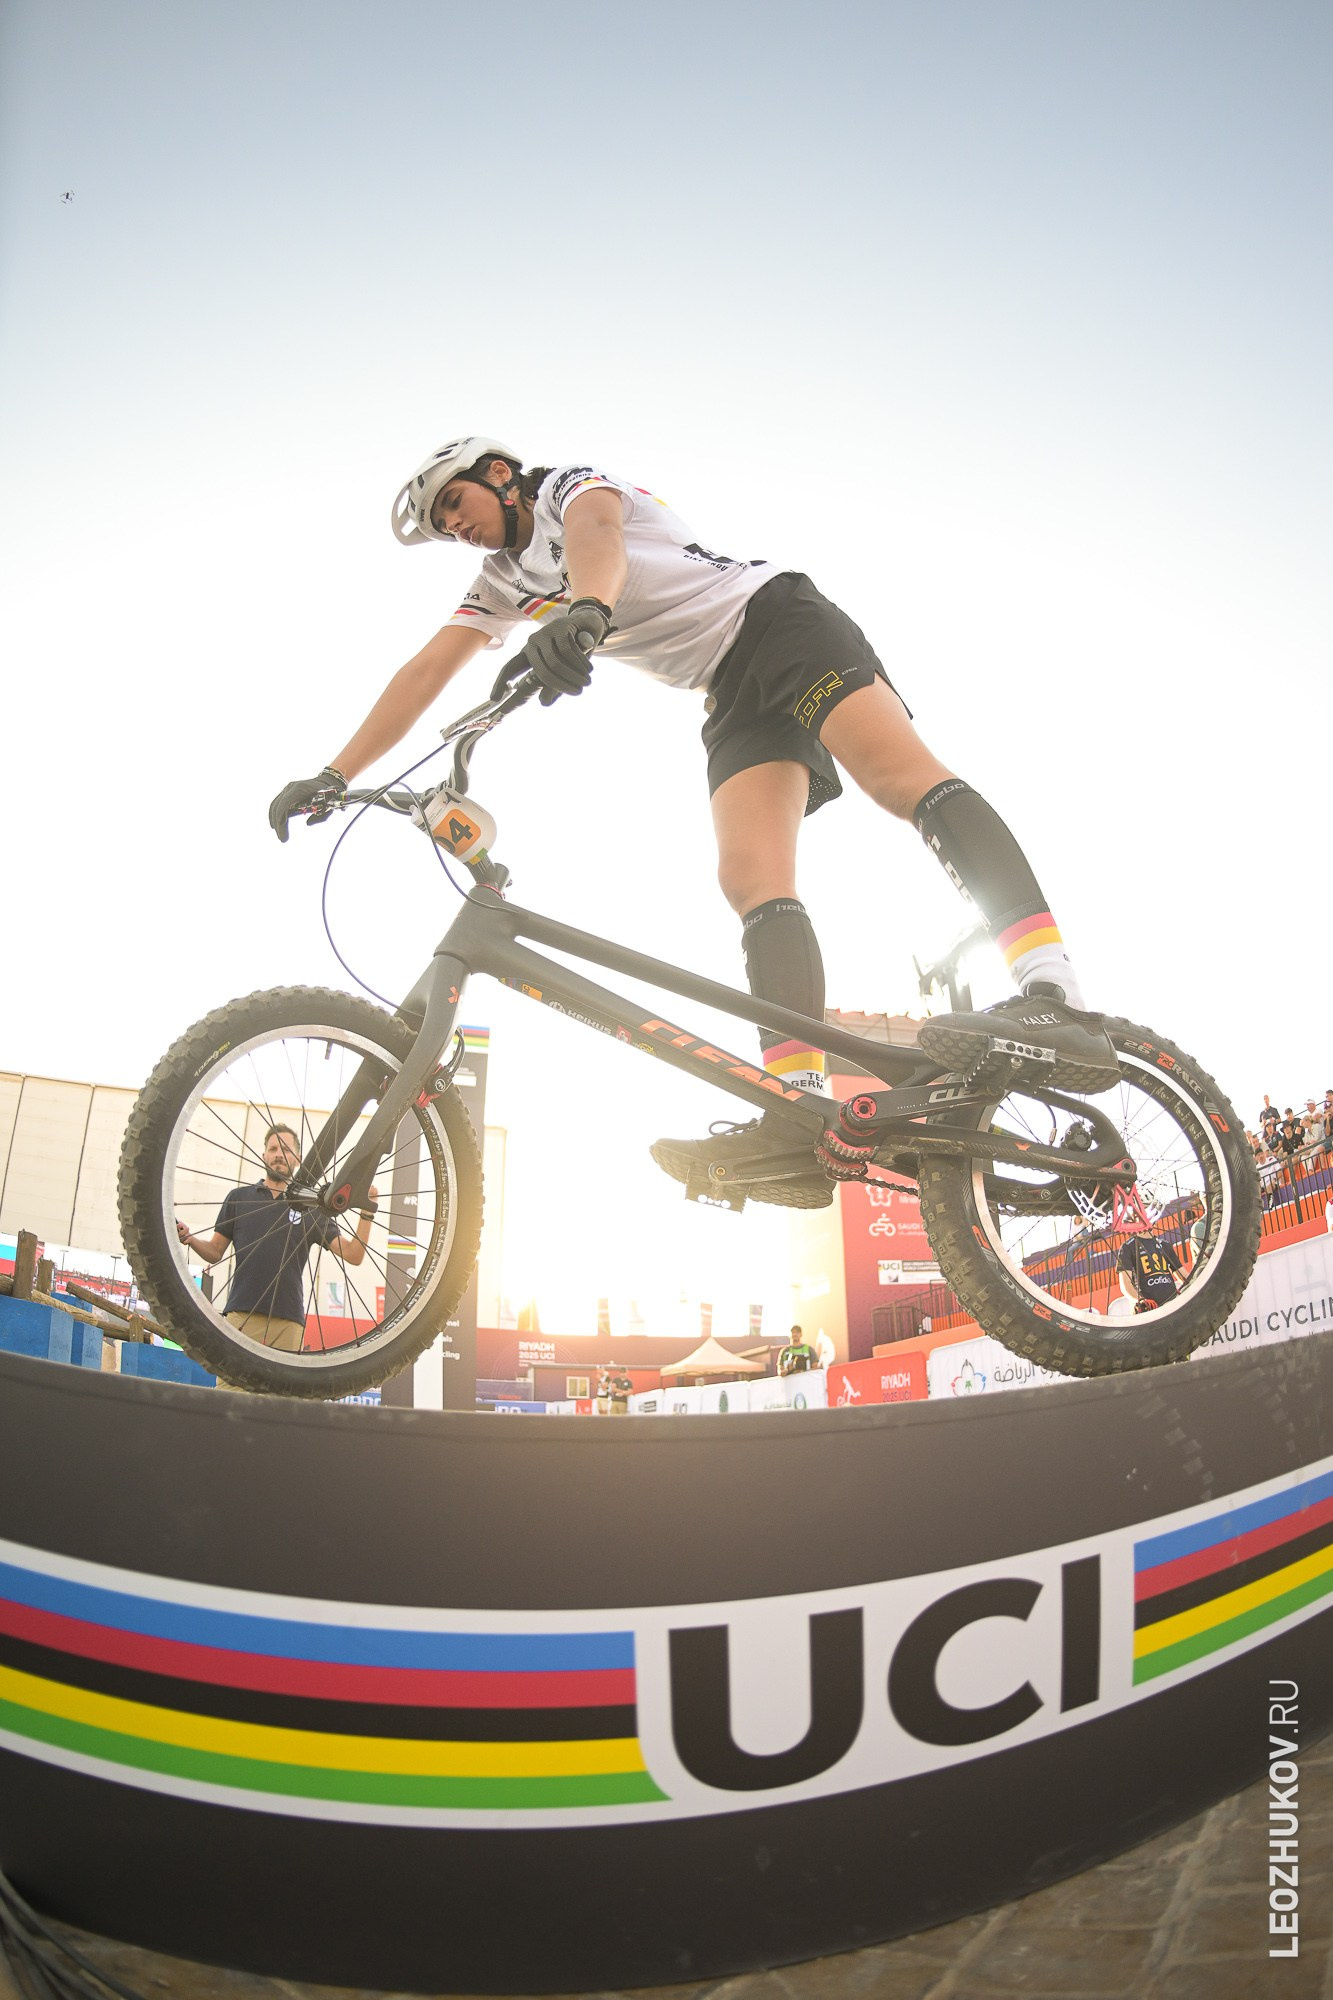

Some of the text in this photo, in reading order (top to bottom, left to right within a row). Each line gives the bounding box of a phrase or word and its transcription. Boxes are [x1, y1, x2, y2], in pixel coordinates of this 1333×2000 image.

[925, 783, 966, 810] hebo
[518, 1341, 556, 1352] RIYADH
[518, 1351, 539, 1360] 2025
[881, 1372, 911, 1389] RIYADH
[668, 1554, 1101, 1791] UCI
